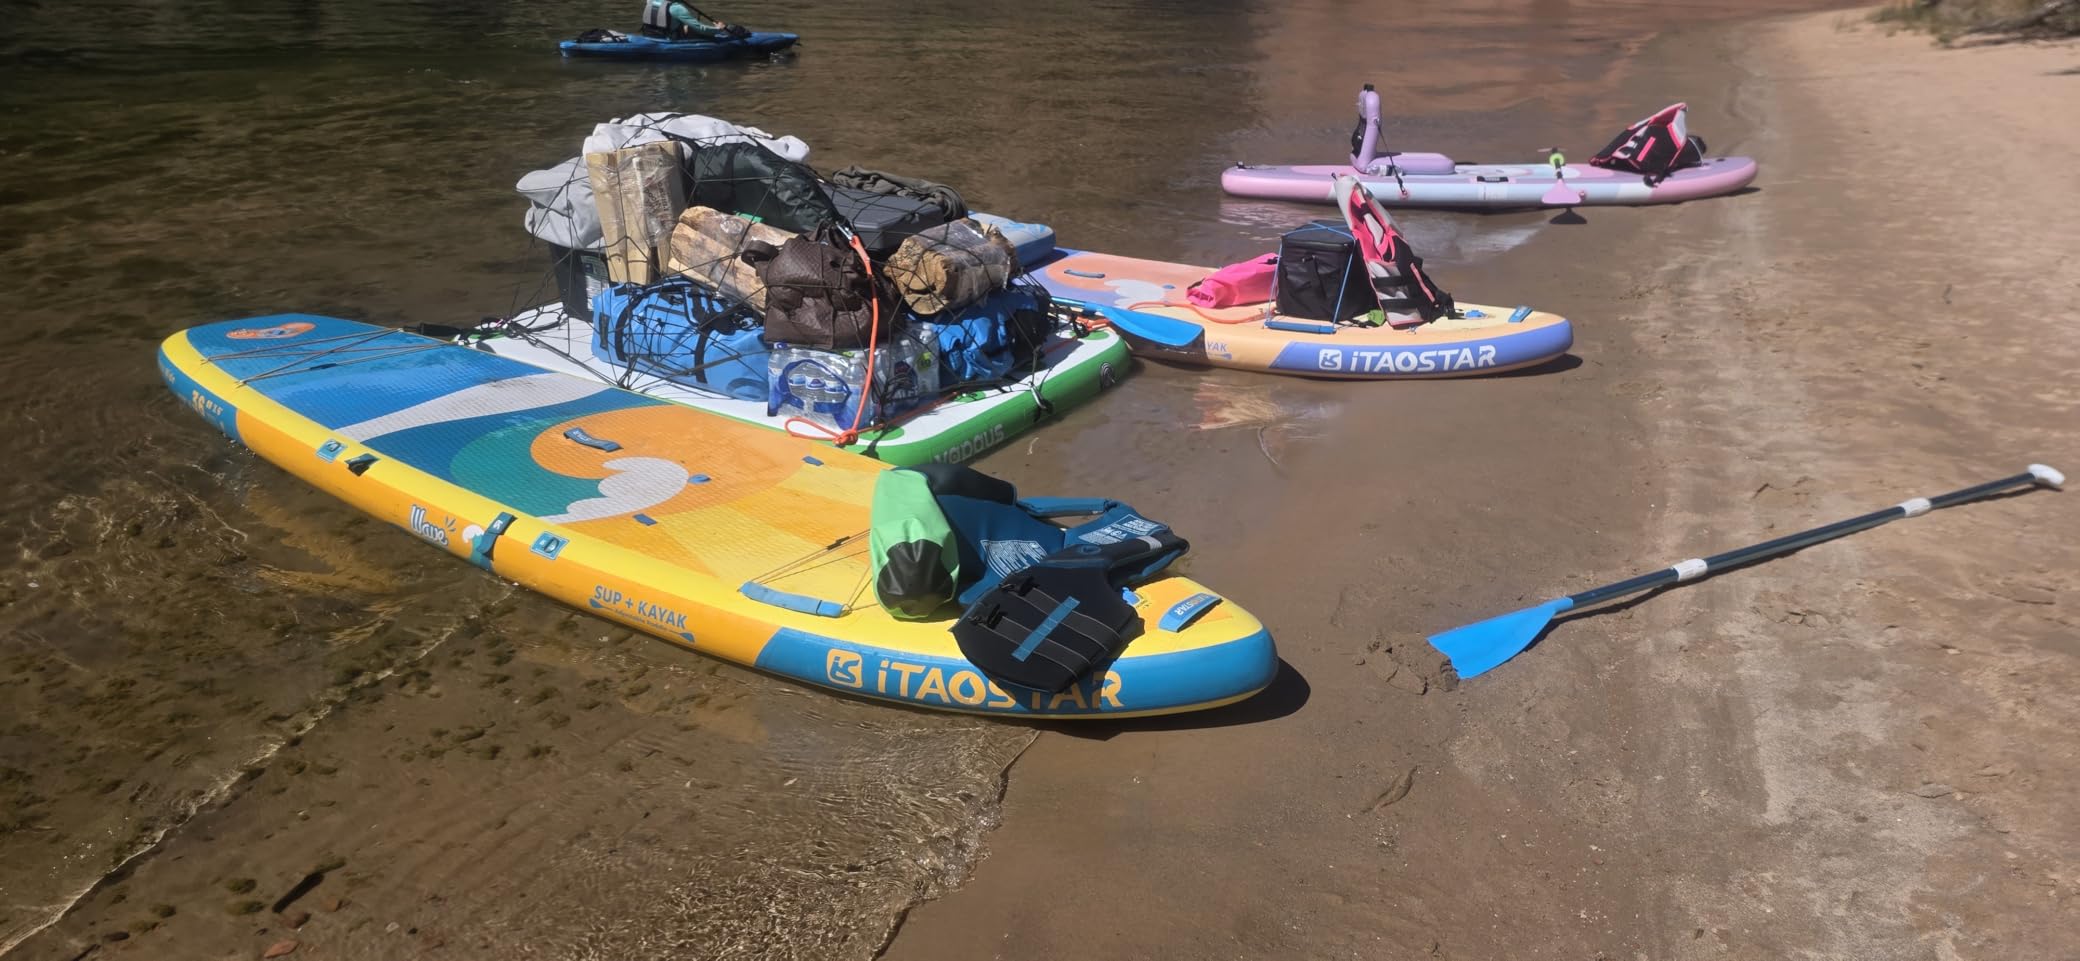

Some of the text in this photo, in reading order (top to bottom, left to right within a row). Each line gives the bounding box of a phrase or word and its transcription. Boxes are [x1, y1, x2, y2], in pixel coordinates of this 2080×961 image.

[1351, 345, 1496, 372] iTAOSTAR
[411, 504, 448, 545] Wave
[594, 585, 622, 604] SUP
[638, 601, 688, 629] KAYAK
